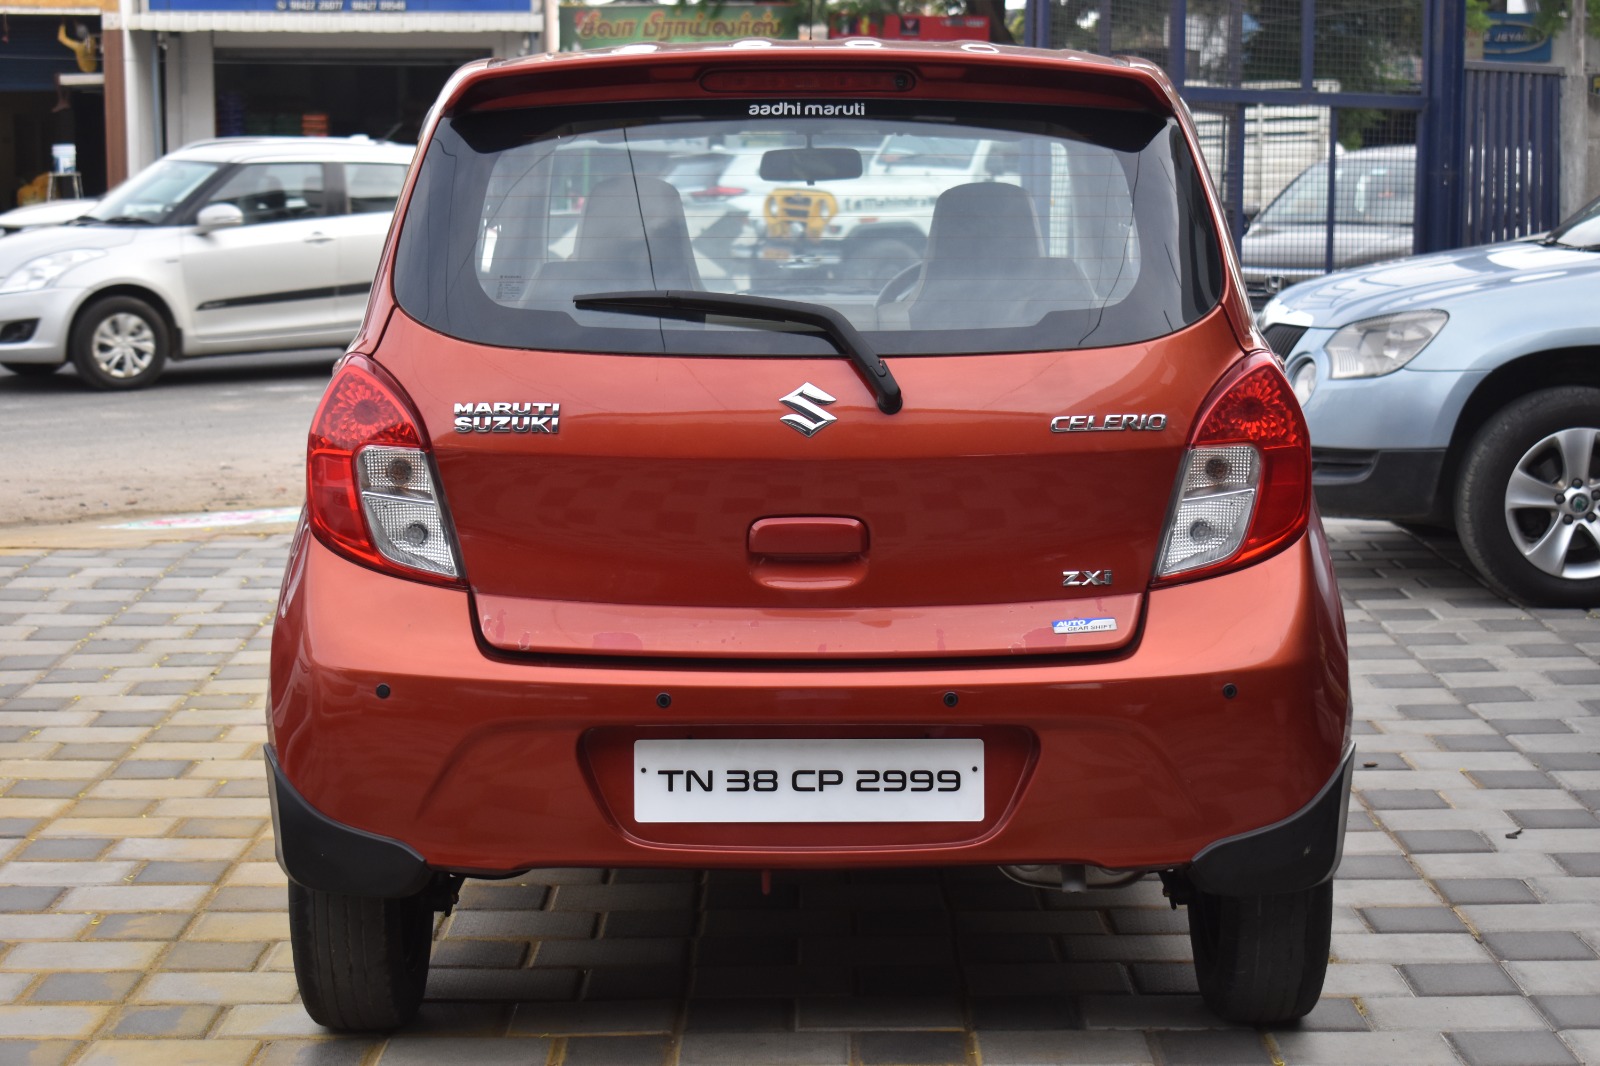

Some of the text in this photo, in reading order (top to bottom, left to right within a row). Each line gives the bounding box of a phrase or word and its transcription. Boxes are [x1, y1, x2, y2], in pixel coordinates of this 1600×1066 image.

[748, 103, 866, 116] aadhi maruti
[453, 402, 560, 416] MARUTI
[453, 416, 560, 434] SUZUKI
[1050, 413, 1167, 433] CELERIO
[1056, 619, 1086, 627] AUTO
[658, 770, 961, 792] TN 38 CP 2999
